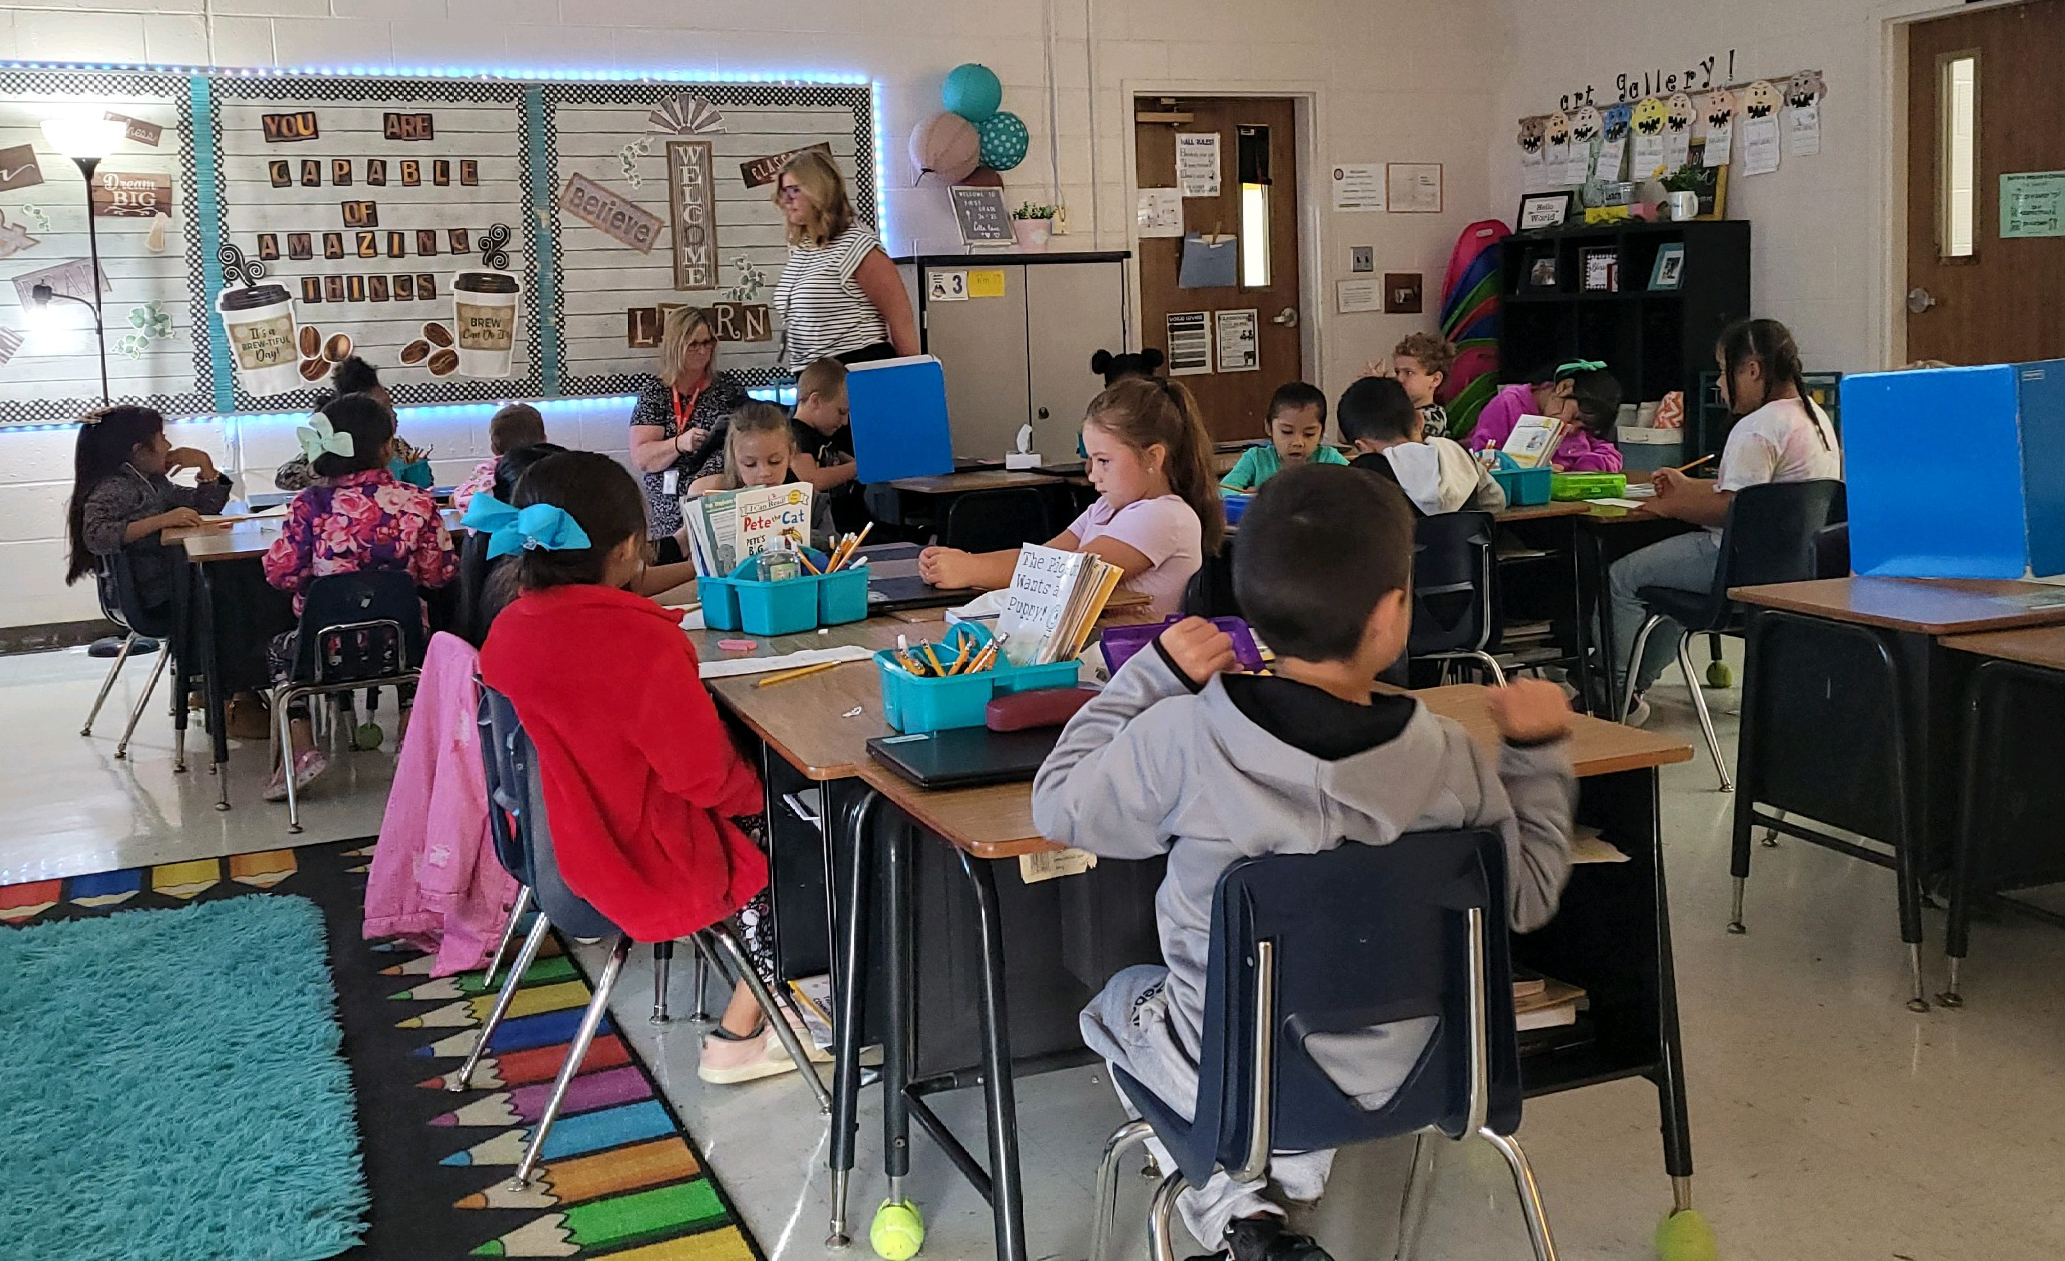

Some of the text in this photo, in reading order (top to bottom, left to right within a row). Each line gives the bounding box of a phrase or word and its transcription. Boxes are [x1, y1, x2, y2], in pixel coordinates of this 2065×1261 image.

[1560, 85, 1594, 111] art
[264, 112, 430, 139] YOU ARE
[103, 173, 156, 190] Dream
[270, 161, 478, 185] CAPABLE
[112, 191, 156, 206] BIG
[1536, 203, 1554, 211] Hello
[344, 203, 375, 226] OF
[570, 186, 650, 243] Believe
[676, 146, 707, 286] WELCOME
[1531, 213, 1556, 222] World
[259, 229, 468, 259] AMAZING
[302, 275, 436, 301] THINGS
[952, 274, 963, 294] 3
[470, 317, 502, 328] BREW
[241, 336, 291, 351] BREW-TIFUL
[255, 347, 281, 362] Day!
[743, 516, 771, 532] Pete
[772, 514, 781, 522] the
[782, 509, 805, 525] Cat
[746, 534, 766, 546] PETE'S
[1023, 551, 1044, 569] The
[1016, 573, 1060, 597] Wants a
[1007, 596, 1048, 622] Puppy!
